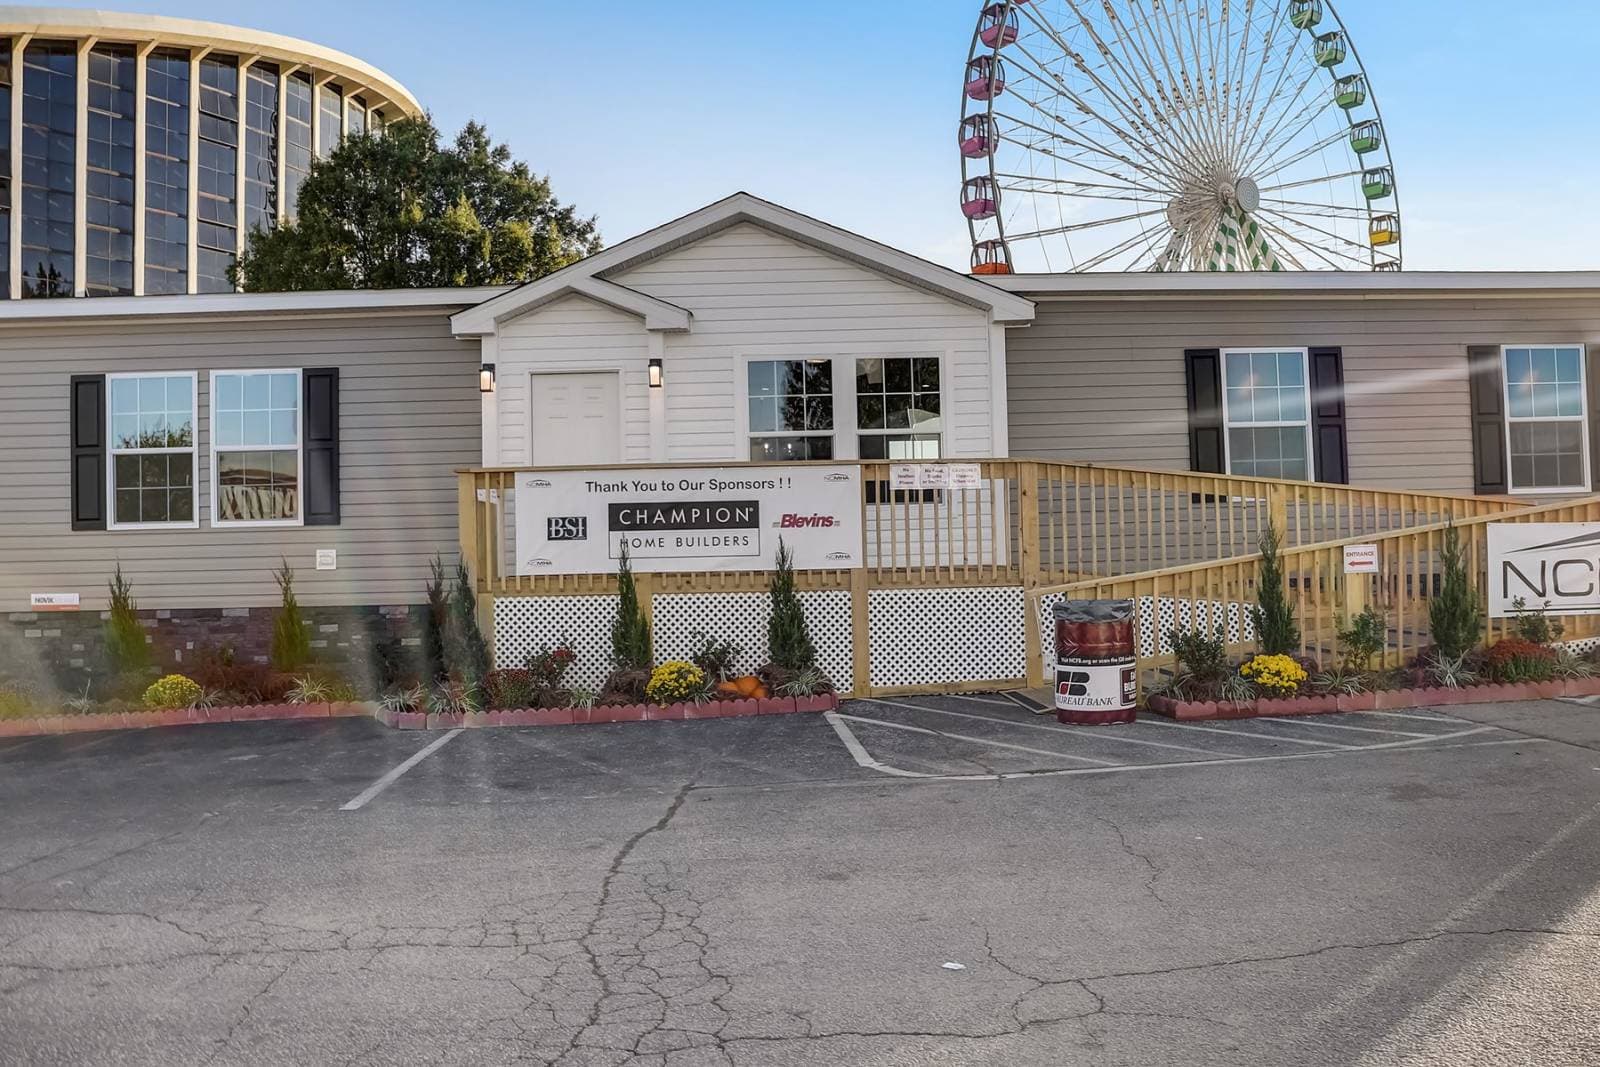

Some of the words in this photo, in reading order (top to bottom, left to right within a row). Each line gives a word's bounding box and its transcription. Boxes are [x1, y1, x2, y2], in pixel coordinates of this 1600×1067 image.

[585, 481, 628, 493] Thank
[632, 480, 657, 492] You
[662, 480, 675, 491] to
[679, 479, 705, 491] Our
[709, 478, 775, 493] Sponsors
[619, 508, 750, 525] CHAMPION
[780, 513, 834, 529] Blevins
[549, 517, 585, 539] BSI
[620, 537, 665, 549] HOME
[676, 535, 749, 548] BUILDERS
[1502, 558, 1600, 599] NC
[1086, 697, 1116, 706] BANK
